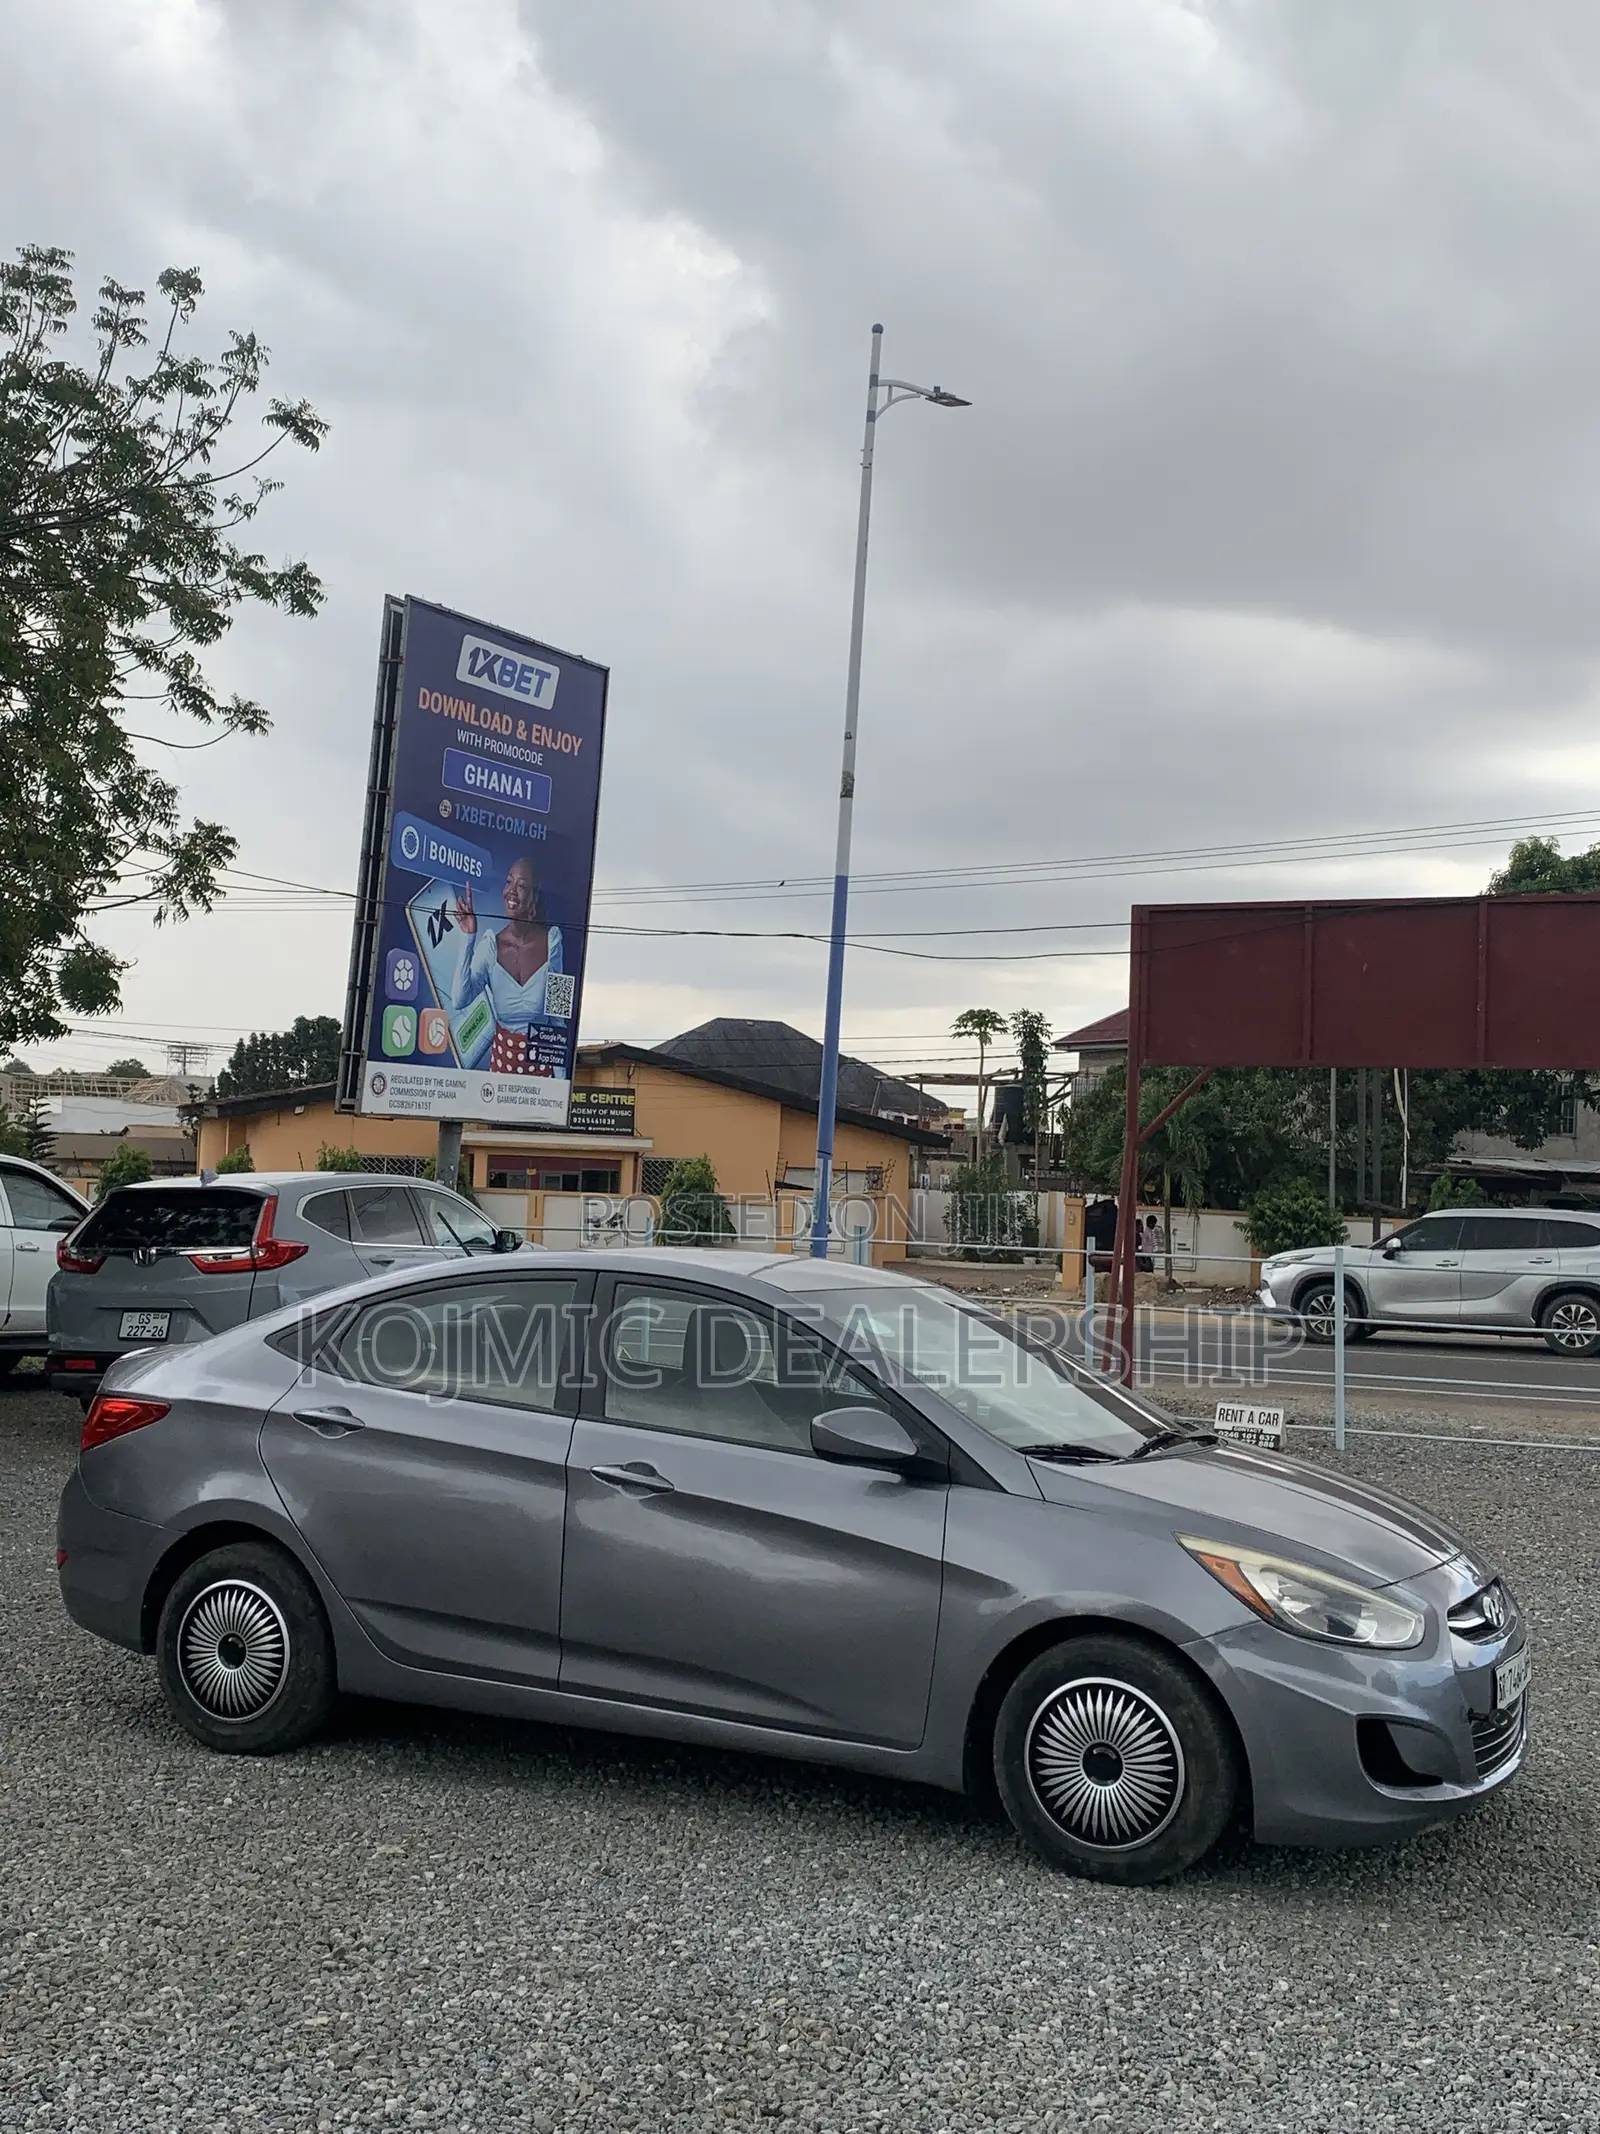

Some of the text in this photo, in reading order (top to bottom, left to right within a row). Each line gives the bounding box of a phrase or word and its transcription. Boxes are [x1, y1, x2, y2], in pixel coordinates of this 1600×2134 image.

[468, 646, 551, 699] 1XBET
[418, 687, 583, 757] DOWNLOAD & ENJOY
[456, 728, 544, 767] WITH PROMOCODE
[464, 763, 532, 801] GHANA1
[454, 803, 547, 841] 1XBET.COM.GH
[429, 840, 483, 878] BONUSES
[539, 1031, 567, 1044] Google Play
[538, 1053, 565, 1064] App Store
[391, 1075, 467, 1089] REGULATED BY THE GAMING
[390, 1087, 457, 1099] COMMISSION OF GHANA
[482, 1087, 493, 1098] 18+
[497, 1084, 542, 1095] BET RESPONSIBLY
[497, 1095, 564, 1109] GAMING CAN BE ADDICTIVE
[590, 1093, 635, 1105] CENTRE
[609, 1109, 632, 1117] MUSIC
[138, 1313, 151, 1325] GS
[126, 1325, 164, 1337] 227-26
[1218, 1408, 1279, 1426] RENT A CAR
